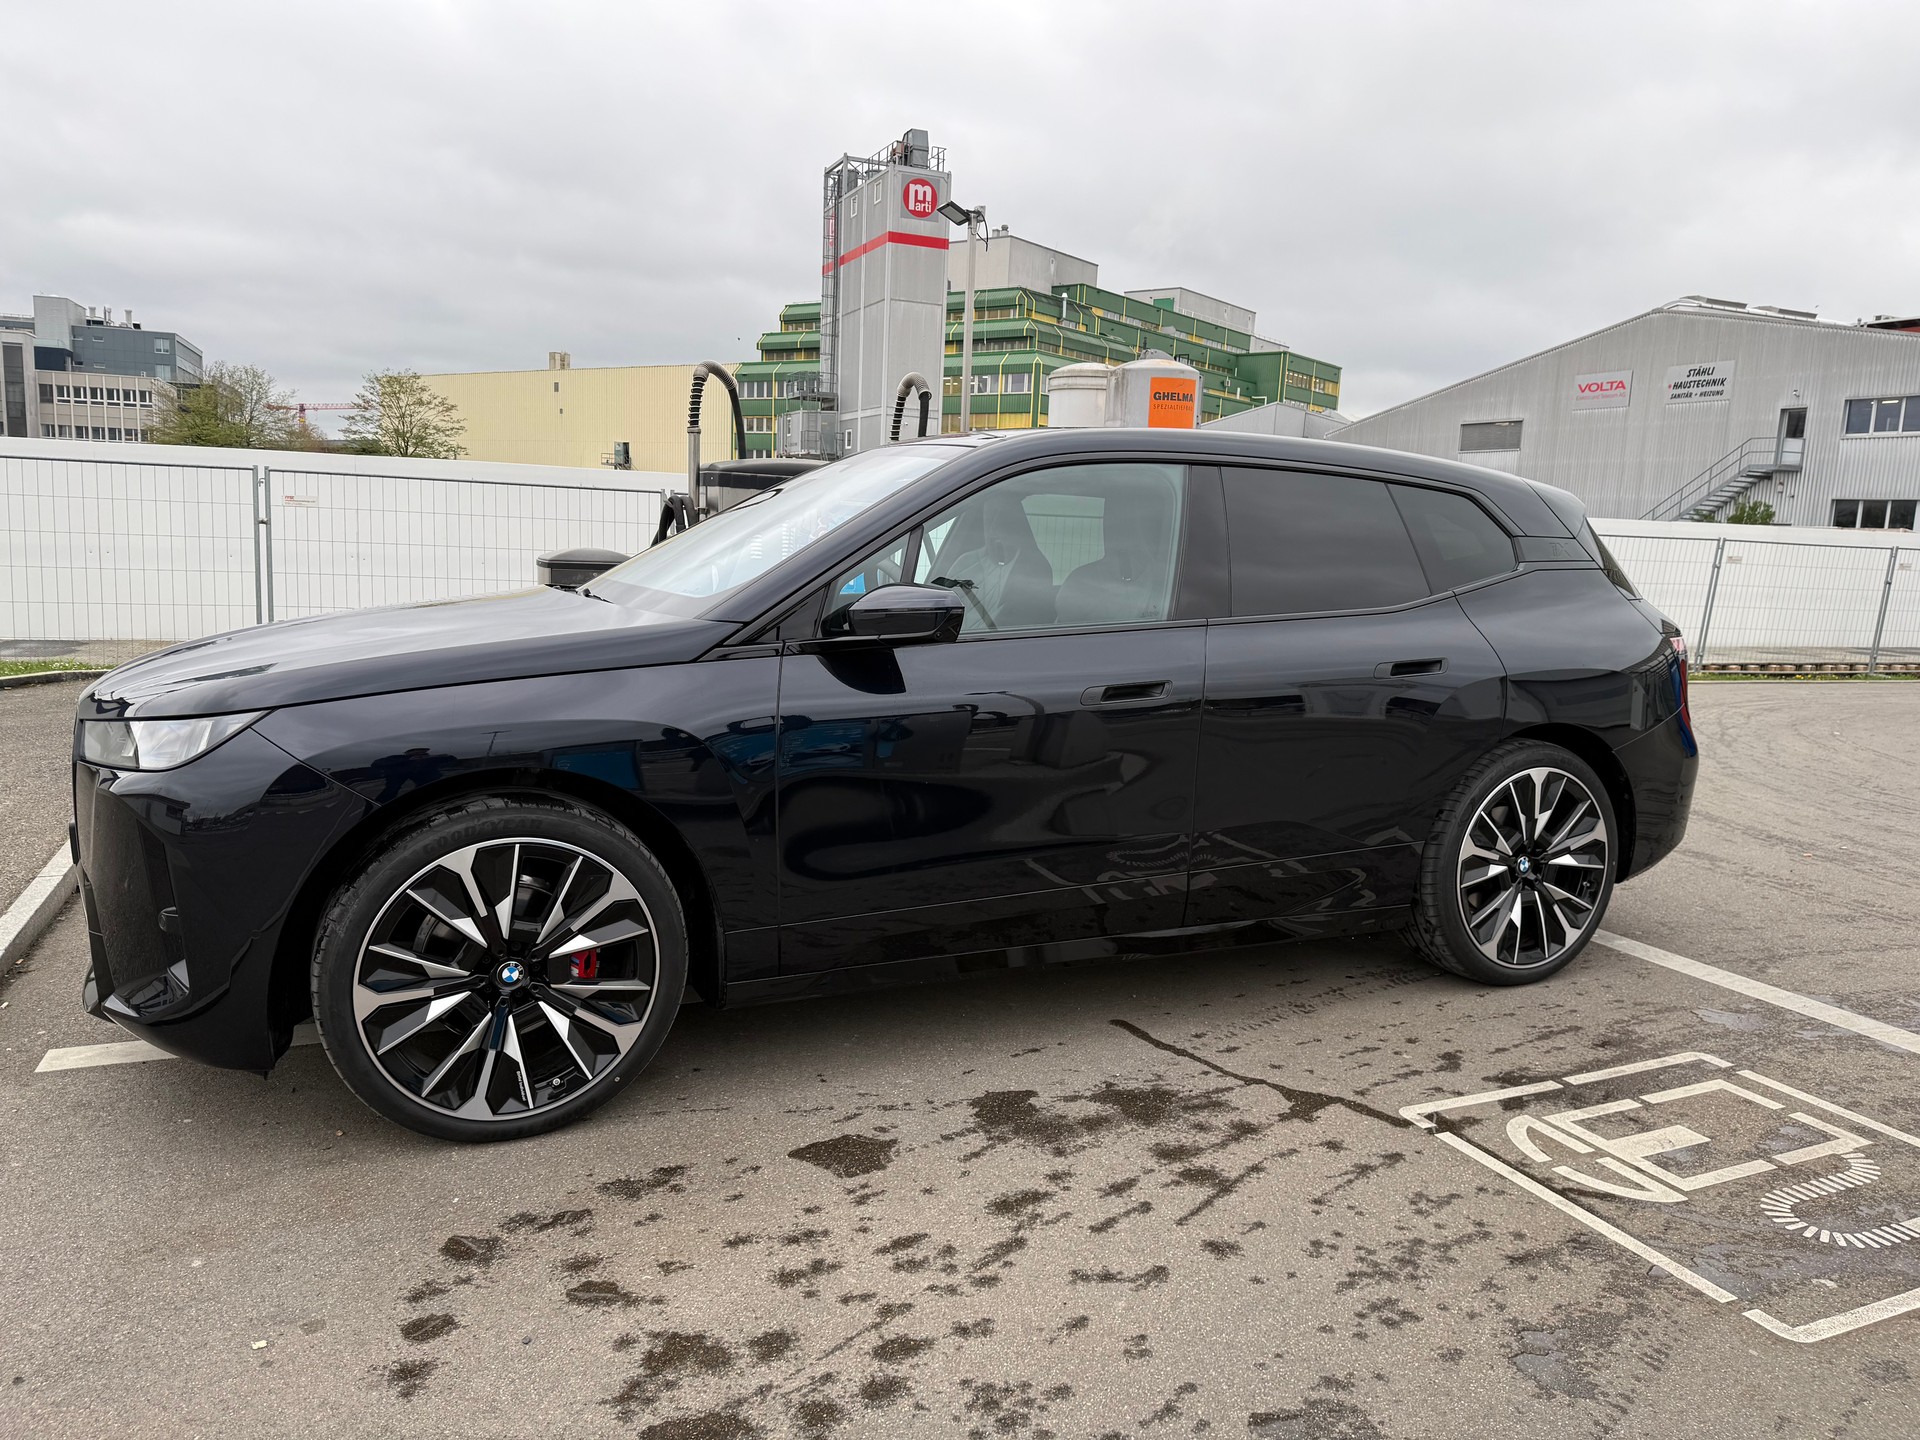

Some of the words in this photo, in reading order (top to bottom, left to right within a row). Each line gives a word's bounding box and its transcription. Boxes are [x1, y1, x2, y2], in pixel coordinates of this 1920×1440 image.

[1686, 366, 1715, 378] STÄHLI
[1578, 380, 1626, 393] VOLTA
[1672, 378, 1726, 390] HAUSTECHNIK
[1153, 391, 1194, 403] GHELMA
[1699, 389, 1724, 398] HEIZUNG
